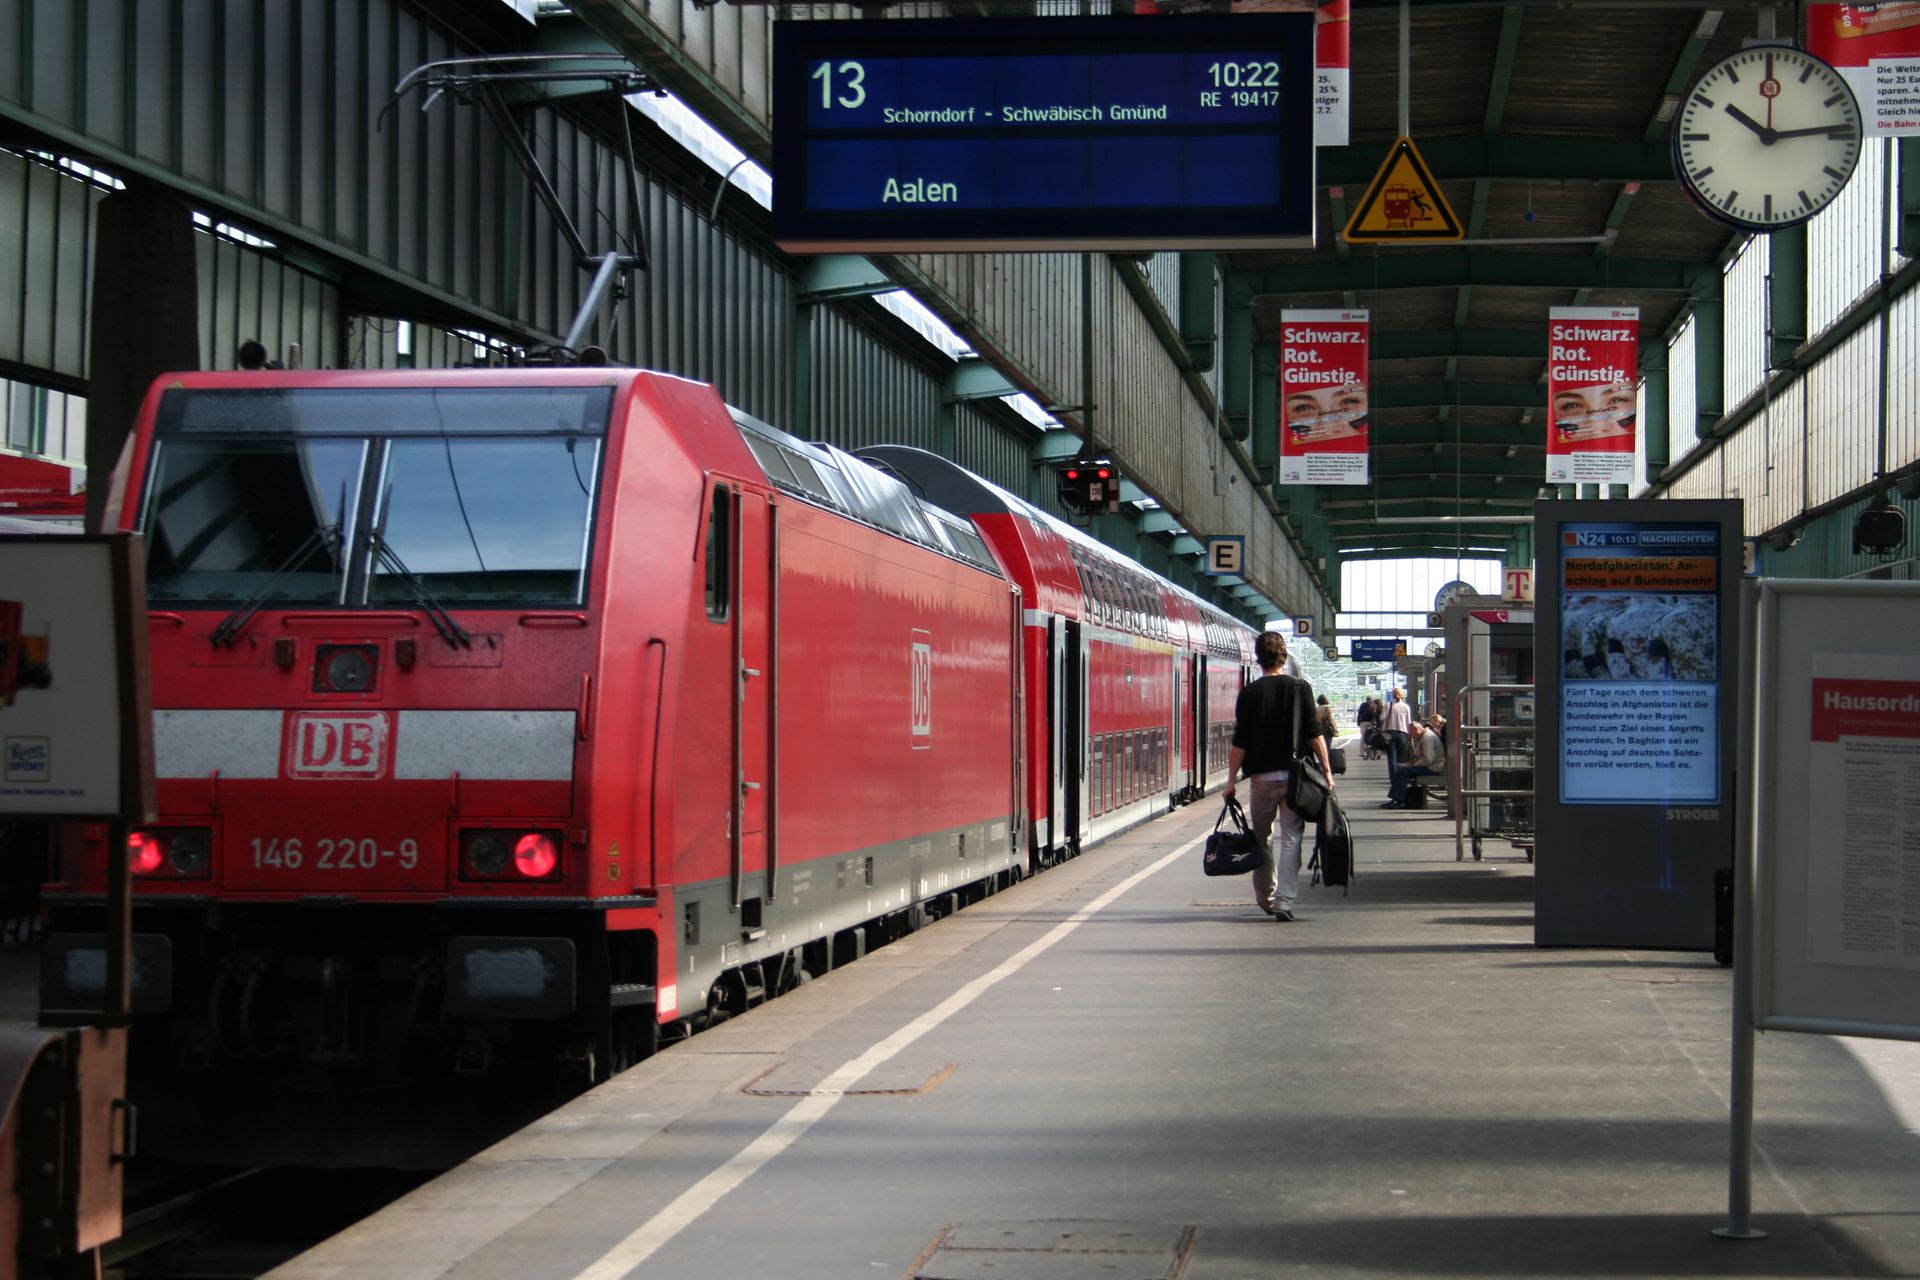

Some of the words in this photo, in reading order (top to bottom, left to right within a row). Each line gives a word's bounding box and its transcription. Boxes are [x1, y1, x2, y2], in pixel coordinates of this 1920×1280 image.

[1208, 63, 1279, 87] 10:22
[1318, 75, 1331, 83] 25.
[1896, 76, 1906, 84] 25
[812, 61, 866, 108] 13
[1877, 88, 1911, 96] sparen.
[1200, 93, 1221, 107] RE
[1230, 91, 1279, 106] 19417
[883, 107, 975, 123] Schorndorf
[1003, 105, 1102, 122] Schwäbisch
[1110, 104, 1167, 121] Gmünd
[1877, 107, 1906, 116] Gleich
[1894, 120, 1917, 128] Bahn
[882, 178, 958, 202] Aalen
[1284, 327, 1366, 344] Schwarz.
[1552, 325, 1635, 341] Schwarz.
[1284, 348, 1323, 363] Rot.
[1552, 345, 1591, 361] Rot.
[1284, 367, 1361, 385] Günstig.
[1552, 365, 1630, 384] Günstig.
[1577, 531, 1606, 546] N24
[1611, 535, 1636, 543] 10:13
[1641, 535, 1714, 543] NACHRICHTEN
[1216, 545, 1233, 568] E
[1566, 559, 1673, 572] Nordafghanistan:
[1677, 560, 1698, 569] An-
[1507, 572, 1529, 599] T
[1566, 575, 1607, 587] schlag
[1611, 576, 1631, 585] auf
[1635, 576, 1713, 585] Bundeswehr
[1298, 621, 1309, 633] D
[1327, 649, 1336, 659] C
[912, 643, 930, 735] DB
[1566, 688, 1587, 696] Fünf
[1589, 689, 1612, 698] Tage
[1661, 689, 1707, 697] schweren
[1566, 700, 1608, 709] Anschlag
[1622, 701, 1677, 710] Afghanistan
[1680, 701, 1691, 709] ist
[1694, 701, 1708, 709] die
[1655, 713, 1687, 722] Region
[1620, 724, 1638, 732] Ziel
[1669, 724, 1705, 734] Angriffs
[299, 719, 378, 769] DB
[1566, 737, 1614, 745] geworden.
[1628, 736, 1666, 745] Baghlan
[1566, 748, 1608, 757] Anschlag
[1673, 748, 1703, 756] Solda-
[1566, 760, 1580, 768] ten
[1583, 760, 1614, 768] verübt
[1615, 760, 1653, 769] worden,
[1655, 760, 1675, 768] hieß
[251, 838, 303, 869] 146
[316, 838, 419, 869] 220-9
